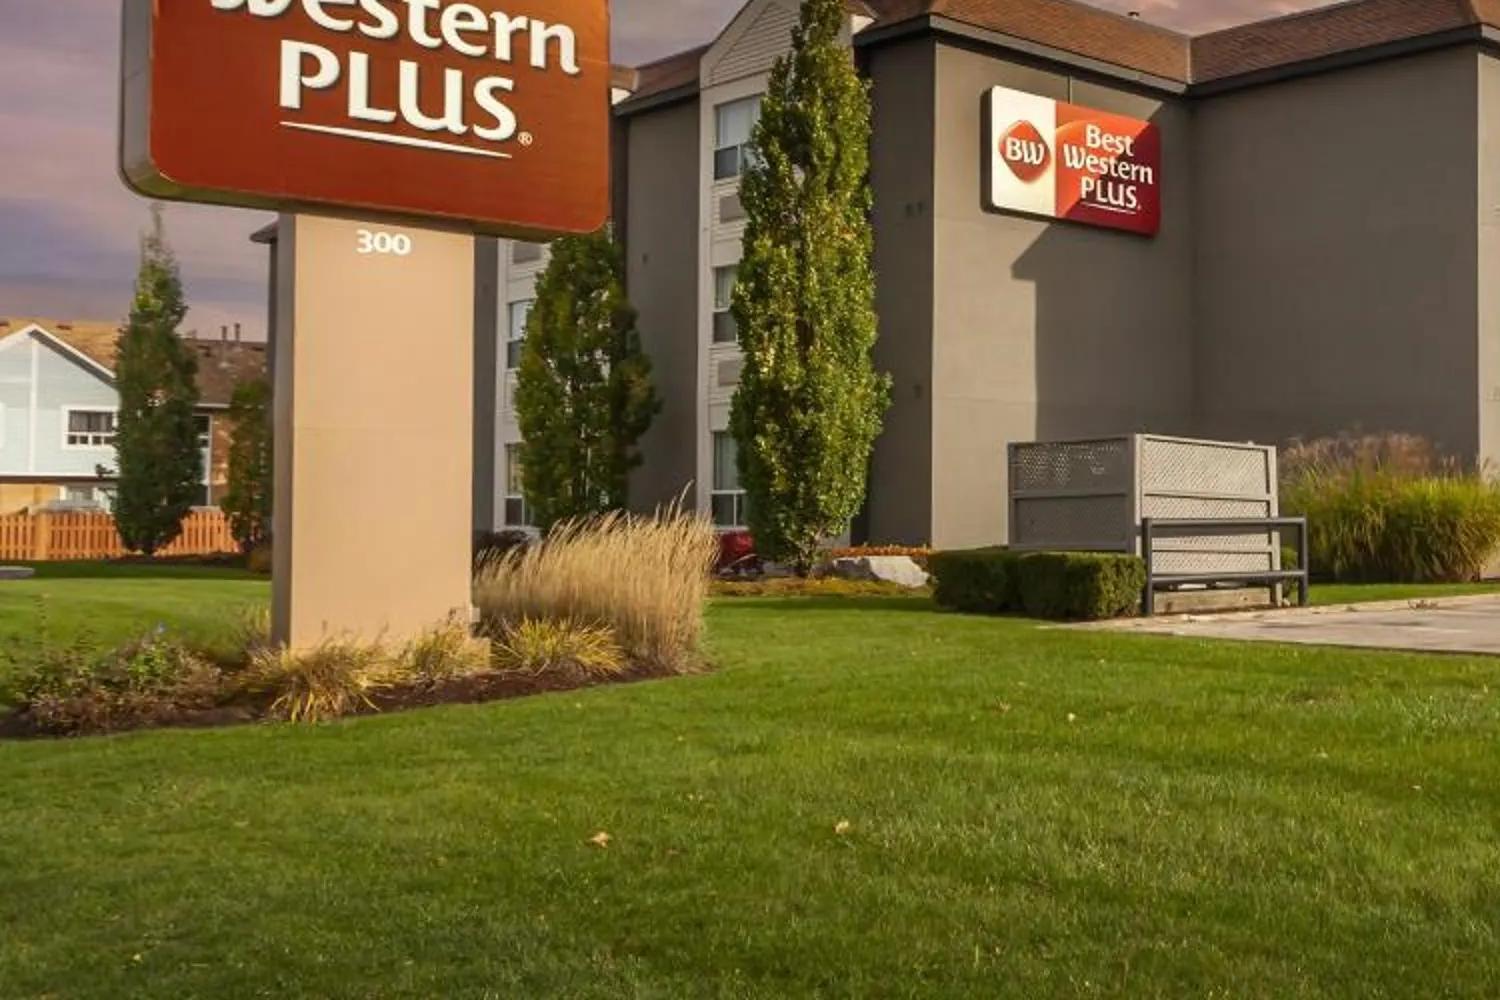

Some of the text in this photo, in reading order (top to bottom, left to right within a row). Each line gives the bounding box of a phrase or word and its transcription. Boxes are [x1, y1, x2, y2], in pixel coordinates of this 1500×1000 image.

[1005, 136, 1045, 165] BW
[1085, 124, 1135, 157] Best
[1063, 144, 1154, 184] Western
[355, 228, 411, 255] 300
